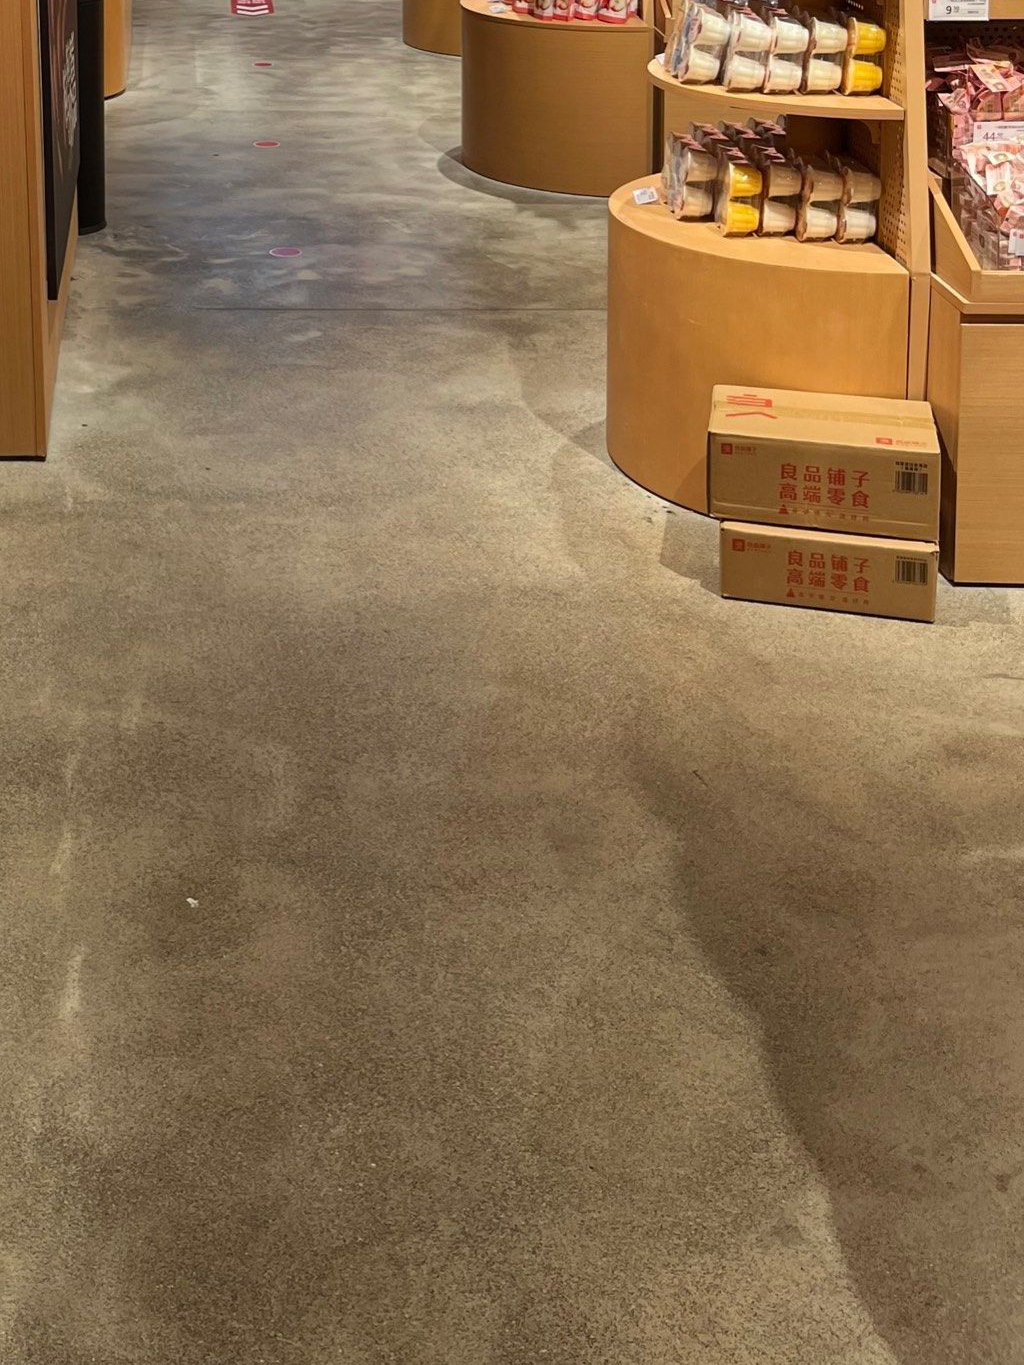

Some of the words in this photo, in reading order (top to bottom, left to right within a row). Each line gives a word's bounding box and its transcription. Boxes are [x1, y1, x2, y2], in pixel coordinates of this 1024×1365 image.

[780, 463, 870, 488] 良品铺子
[779, 483, 870, 509] 高端零食
[787, 549, 871, 574] 良品铺子
[786, 568, 871, 593] 高端零食
